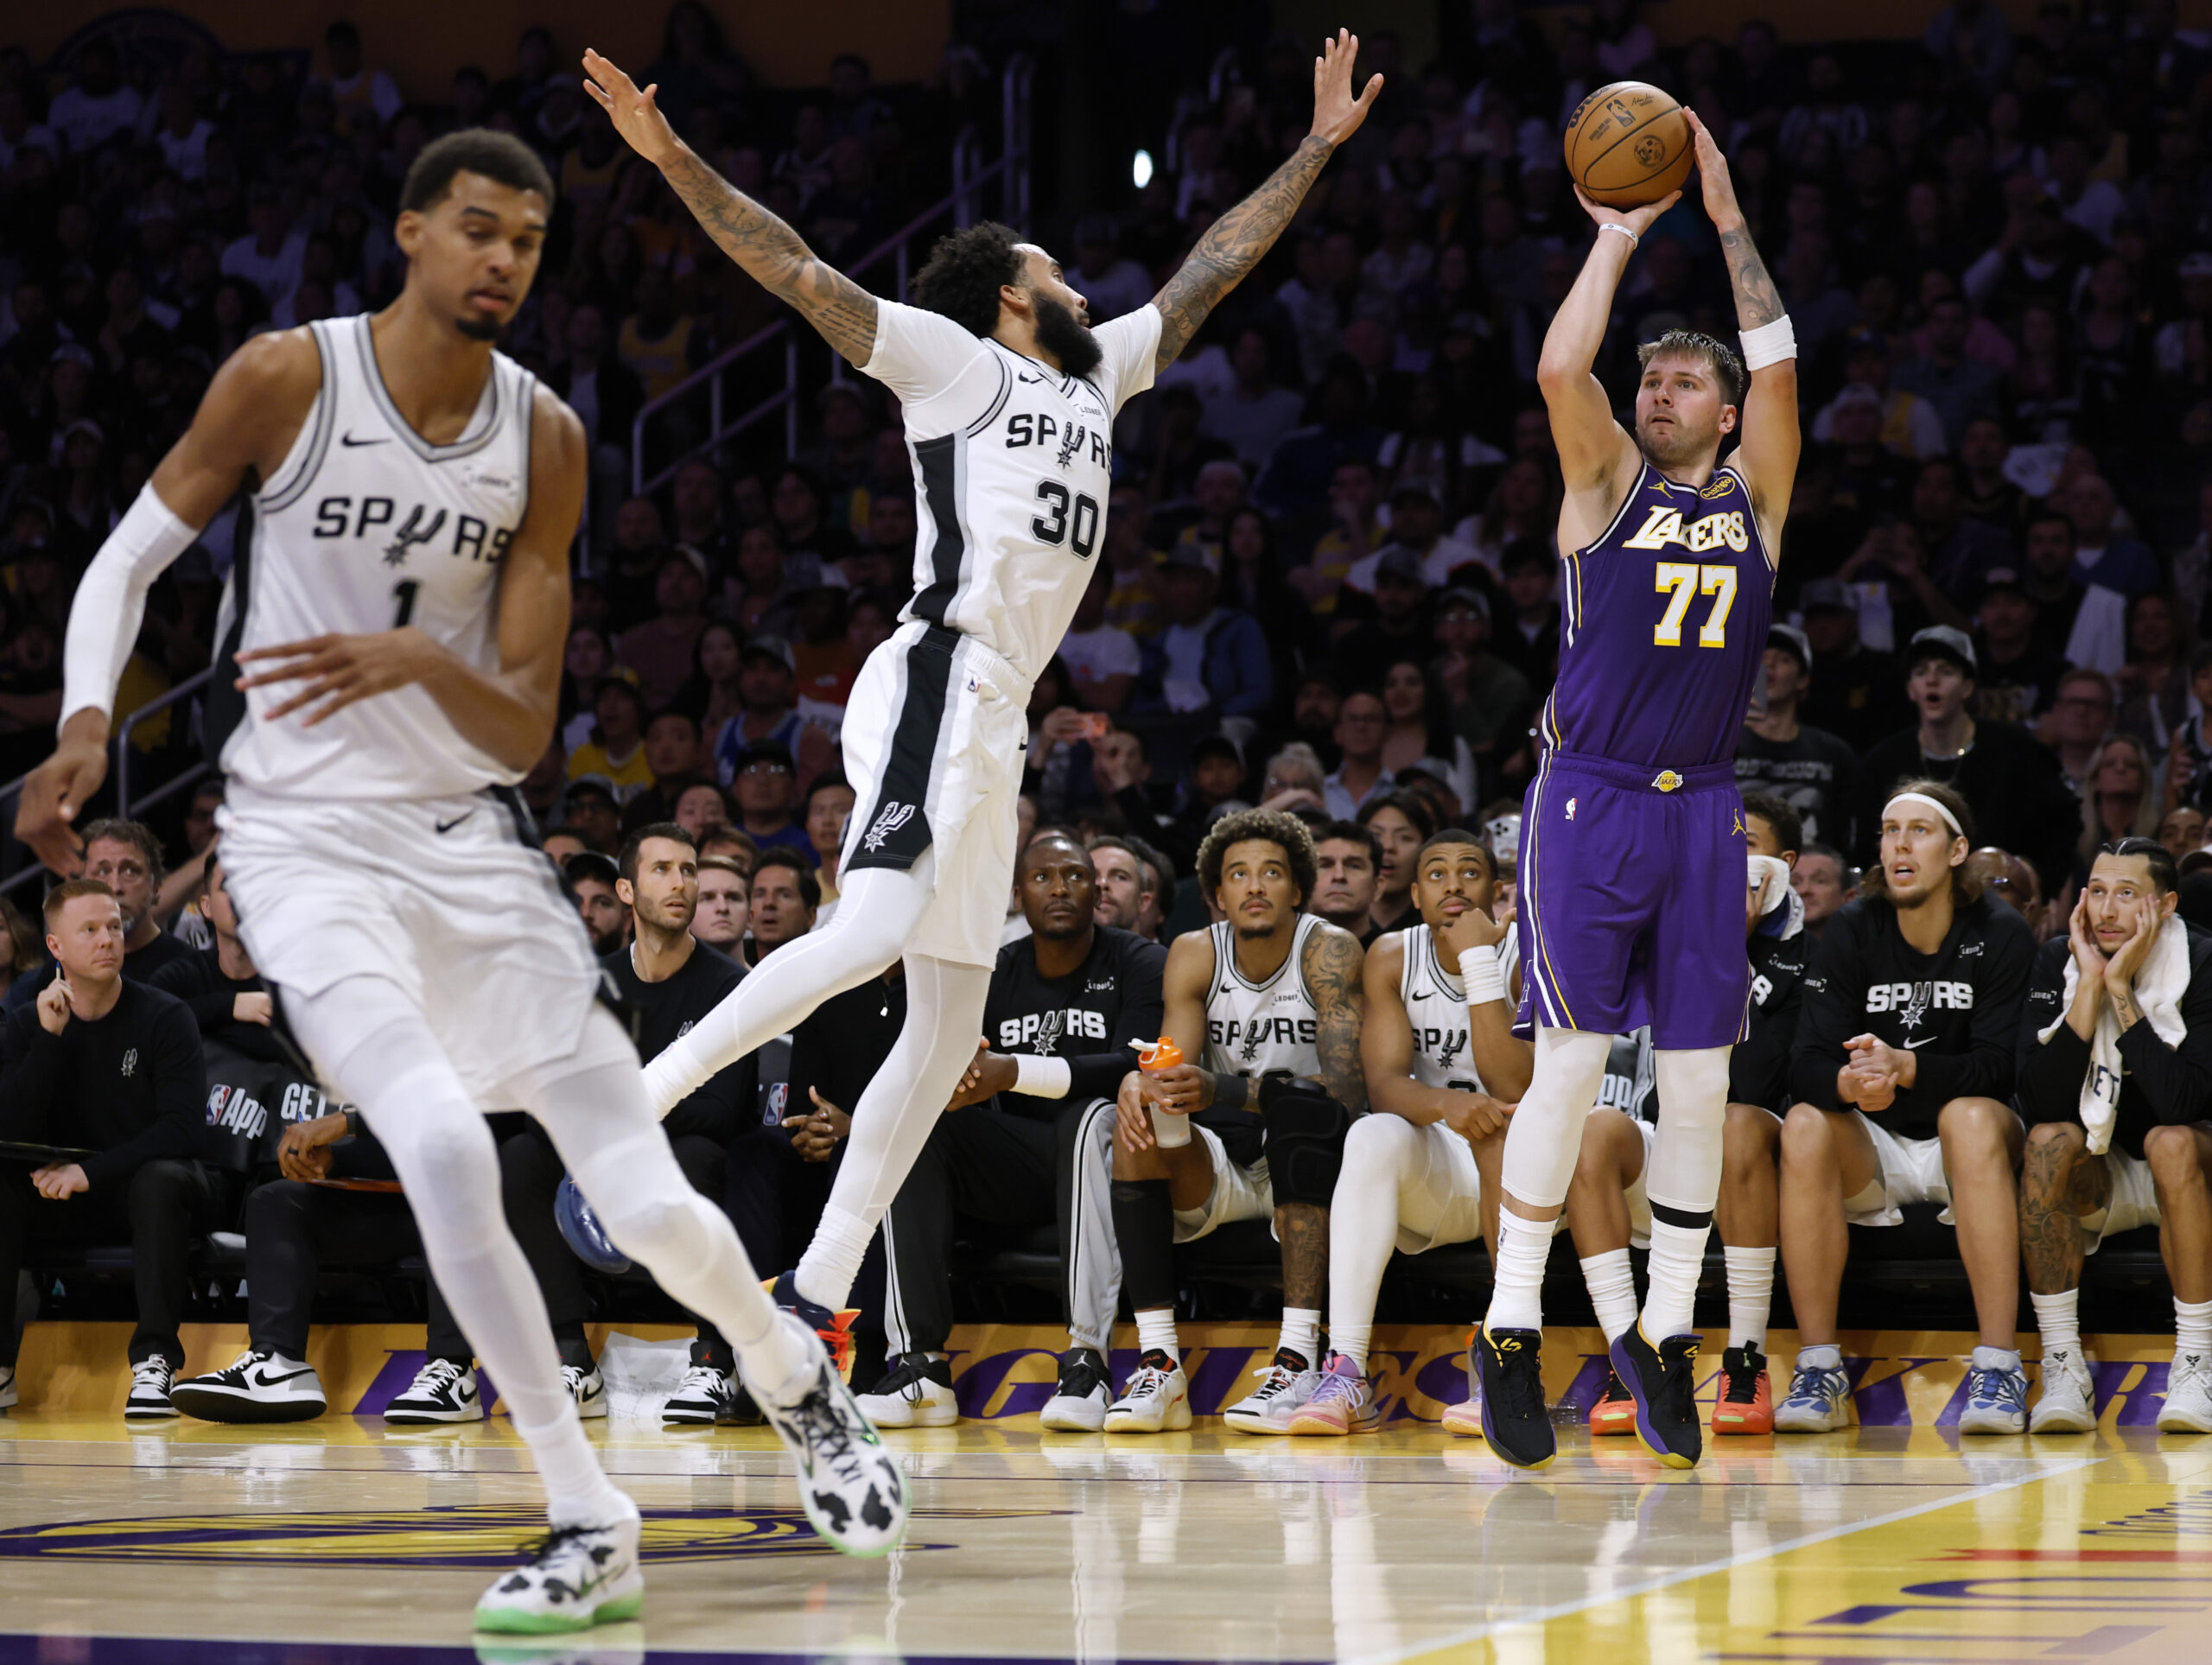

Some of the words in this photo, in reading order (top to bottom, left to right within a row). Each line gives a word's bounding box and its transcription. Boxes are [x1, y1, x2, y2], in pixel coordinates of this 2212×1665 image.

[313, 497, 514, 567] SPURS
[1030, 478, 1099, 561] 30
[393, 579, 422, 629] 1
[1654, 562, 1738, 648] 77
[1866, 981, 1974, 1030] SPURS
[1000, 1008, 1106, 1057] SPURS
[1210, 1018, 1316, 1062] SPURS
[220, 1088, 267, 1140] App
